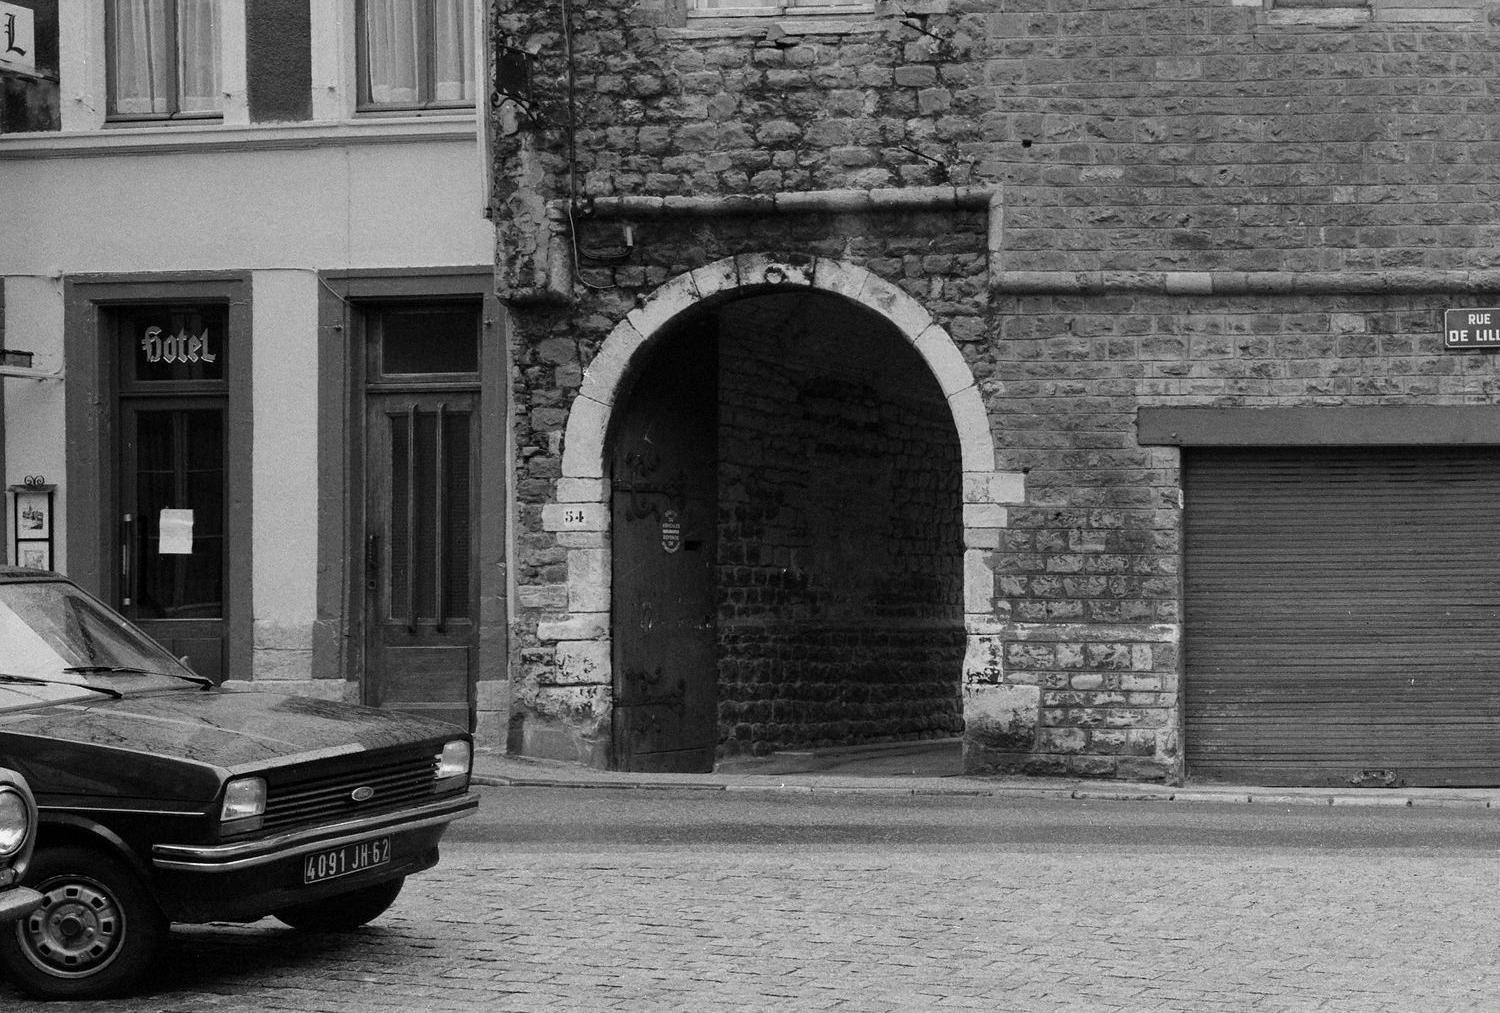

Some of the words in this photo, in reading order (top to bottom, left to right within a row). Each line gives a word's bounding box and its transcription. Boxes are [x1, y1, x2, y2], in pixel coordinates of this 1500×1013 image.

[1468, 313, 1491, 325] RUE
[1449, 330, 1469, 342] DE
[565, 510, 584, 523] 54
[307, 849, 346, 880] 4091
[351, 843, 369, 869] JH
[373, 839, 389, 863] 62
